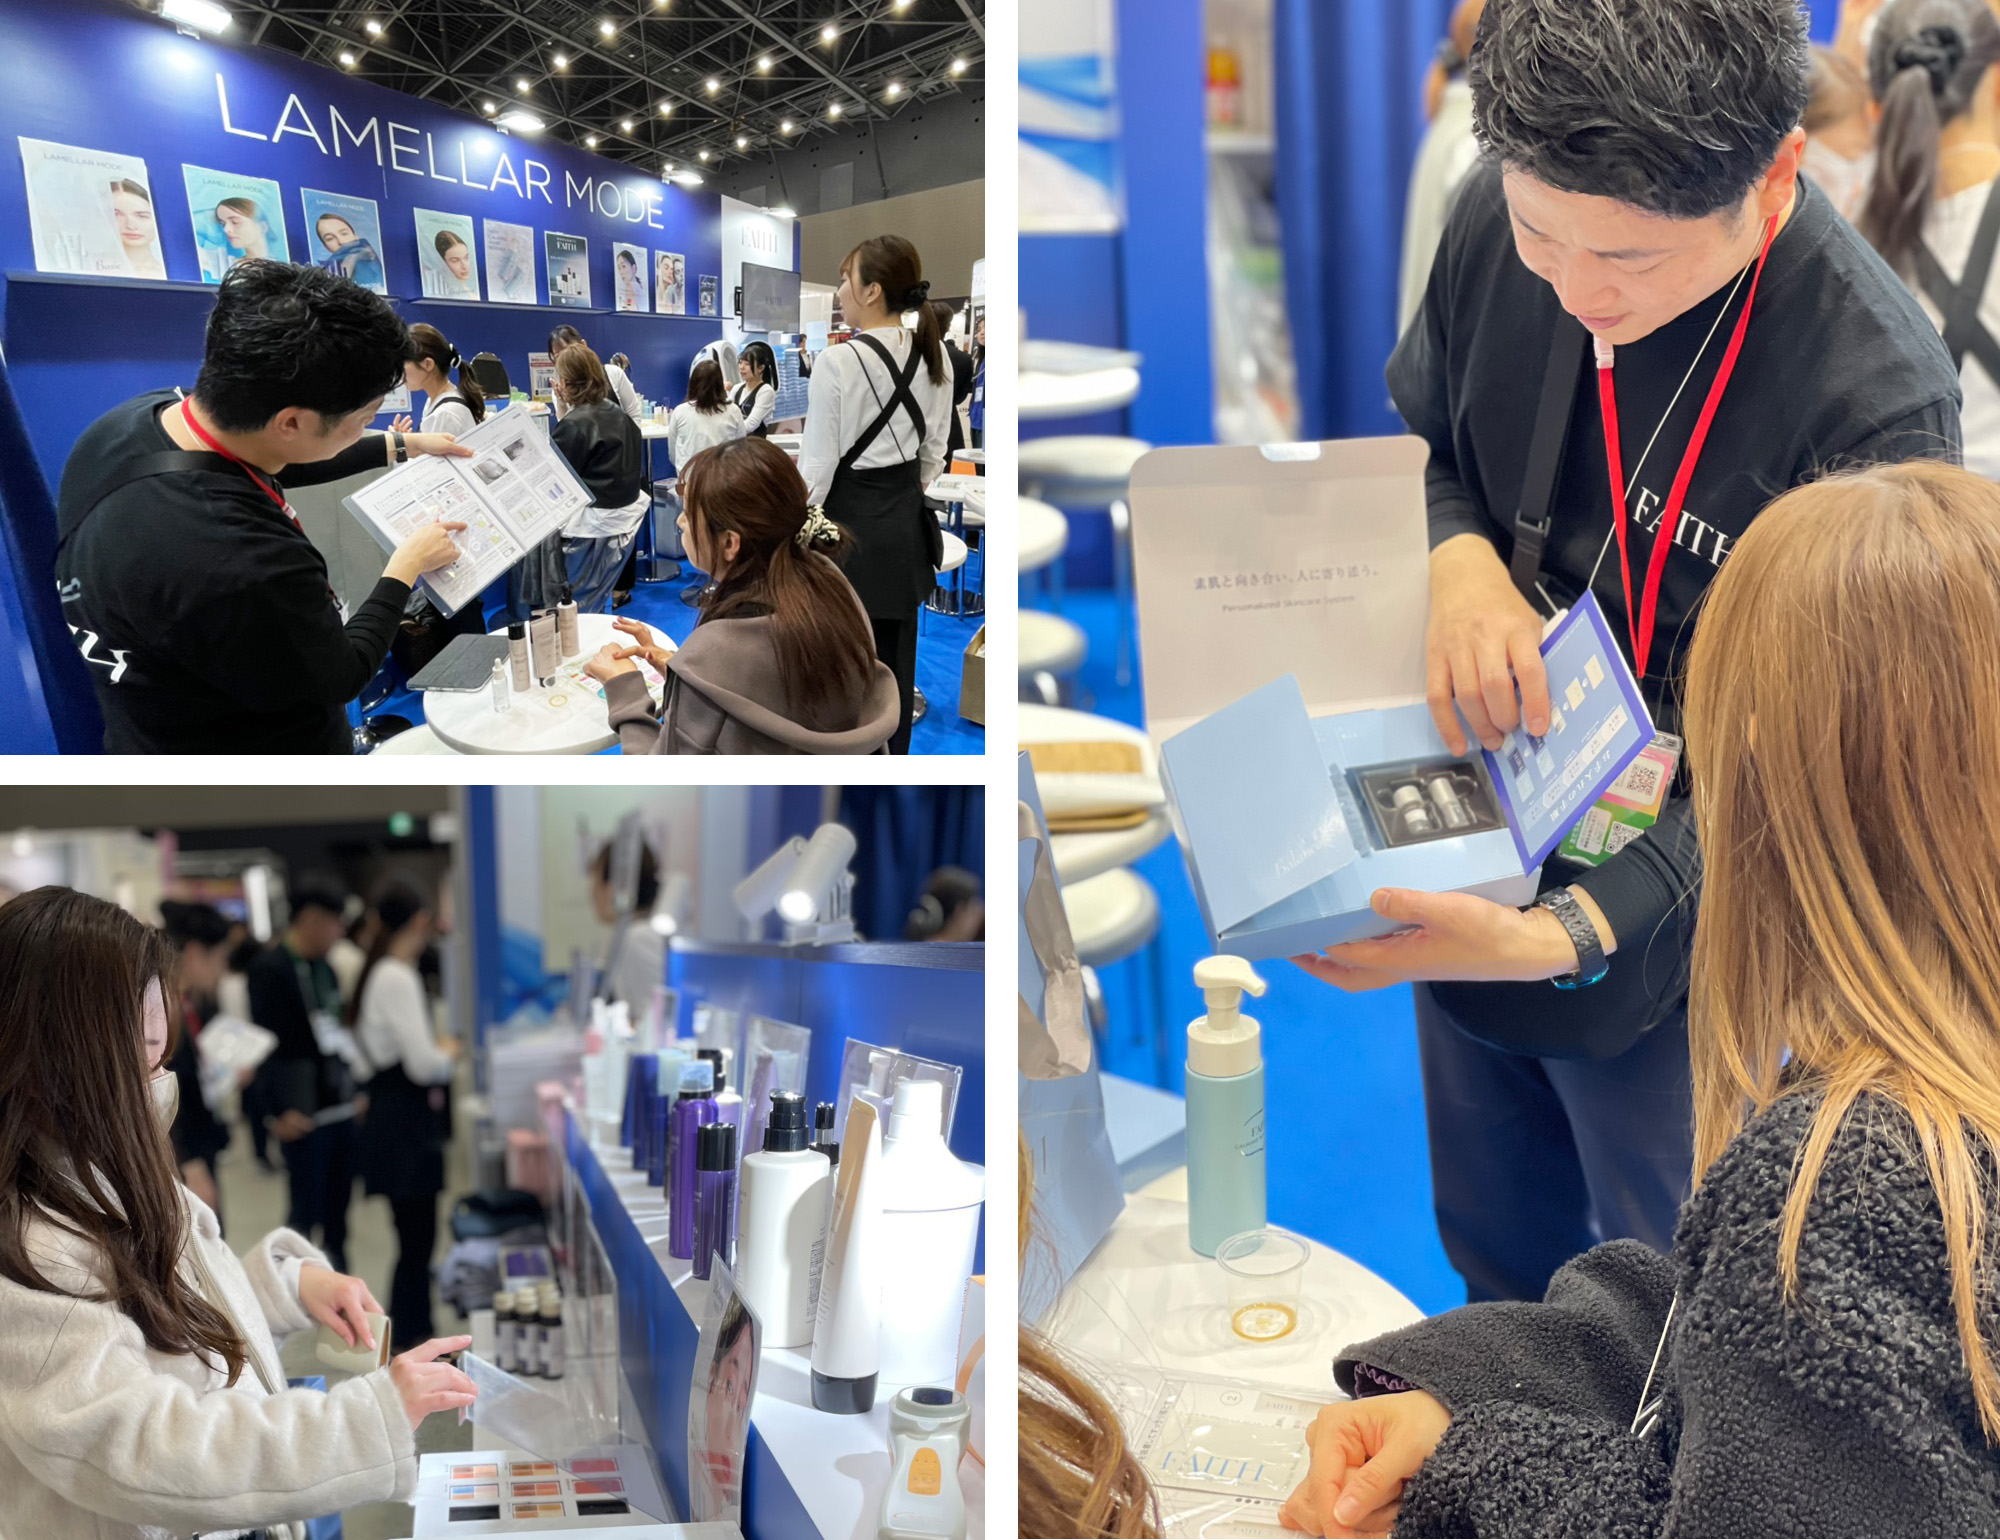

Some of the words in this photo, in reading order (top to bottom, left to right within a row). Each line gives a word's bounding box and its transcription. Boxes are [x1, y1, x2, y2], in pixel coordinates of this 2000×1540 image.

[43, 152, 95, 167] LAMELLAR
[96, 161, 124, 171] MODE
[216, 72, 553, 205] LAMELLAR
[565, 169, 665, 230] MODE
[203, 178, 242, 190] LAMELLAR
[244, 185, 265, 195] MODE
[1194, 564, 1379, 591] 素肌と向き合い、人に寄り添う。
[1222, 599, 1281, 613] Personalized
[1283, 597, 1321, 609] Skincare
[1323, 595, 1356, 606] System
[1161, 1450, 1266, 1483] FAITH
